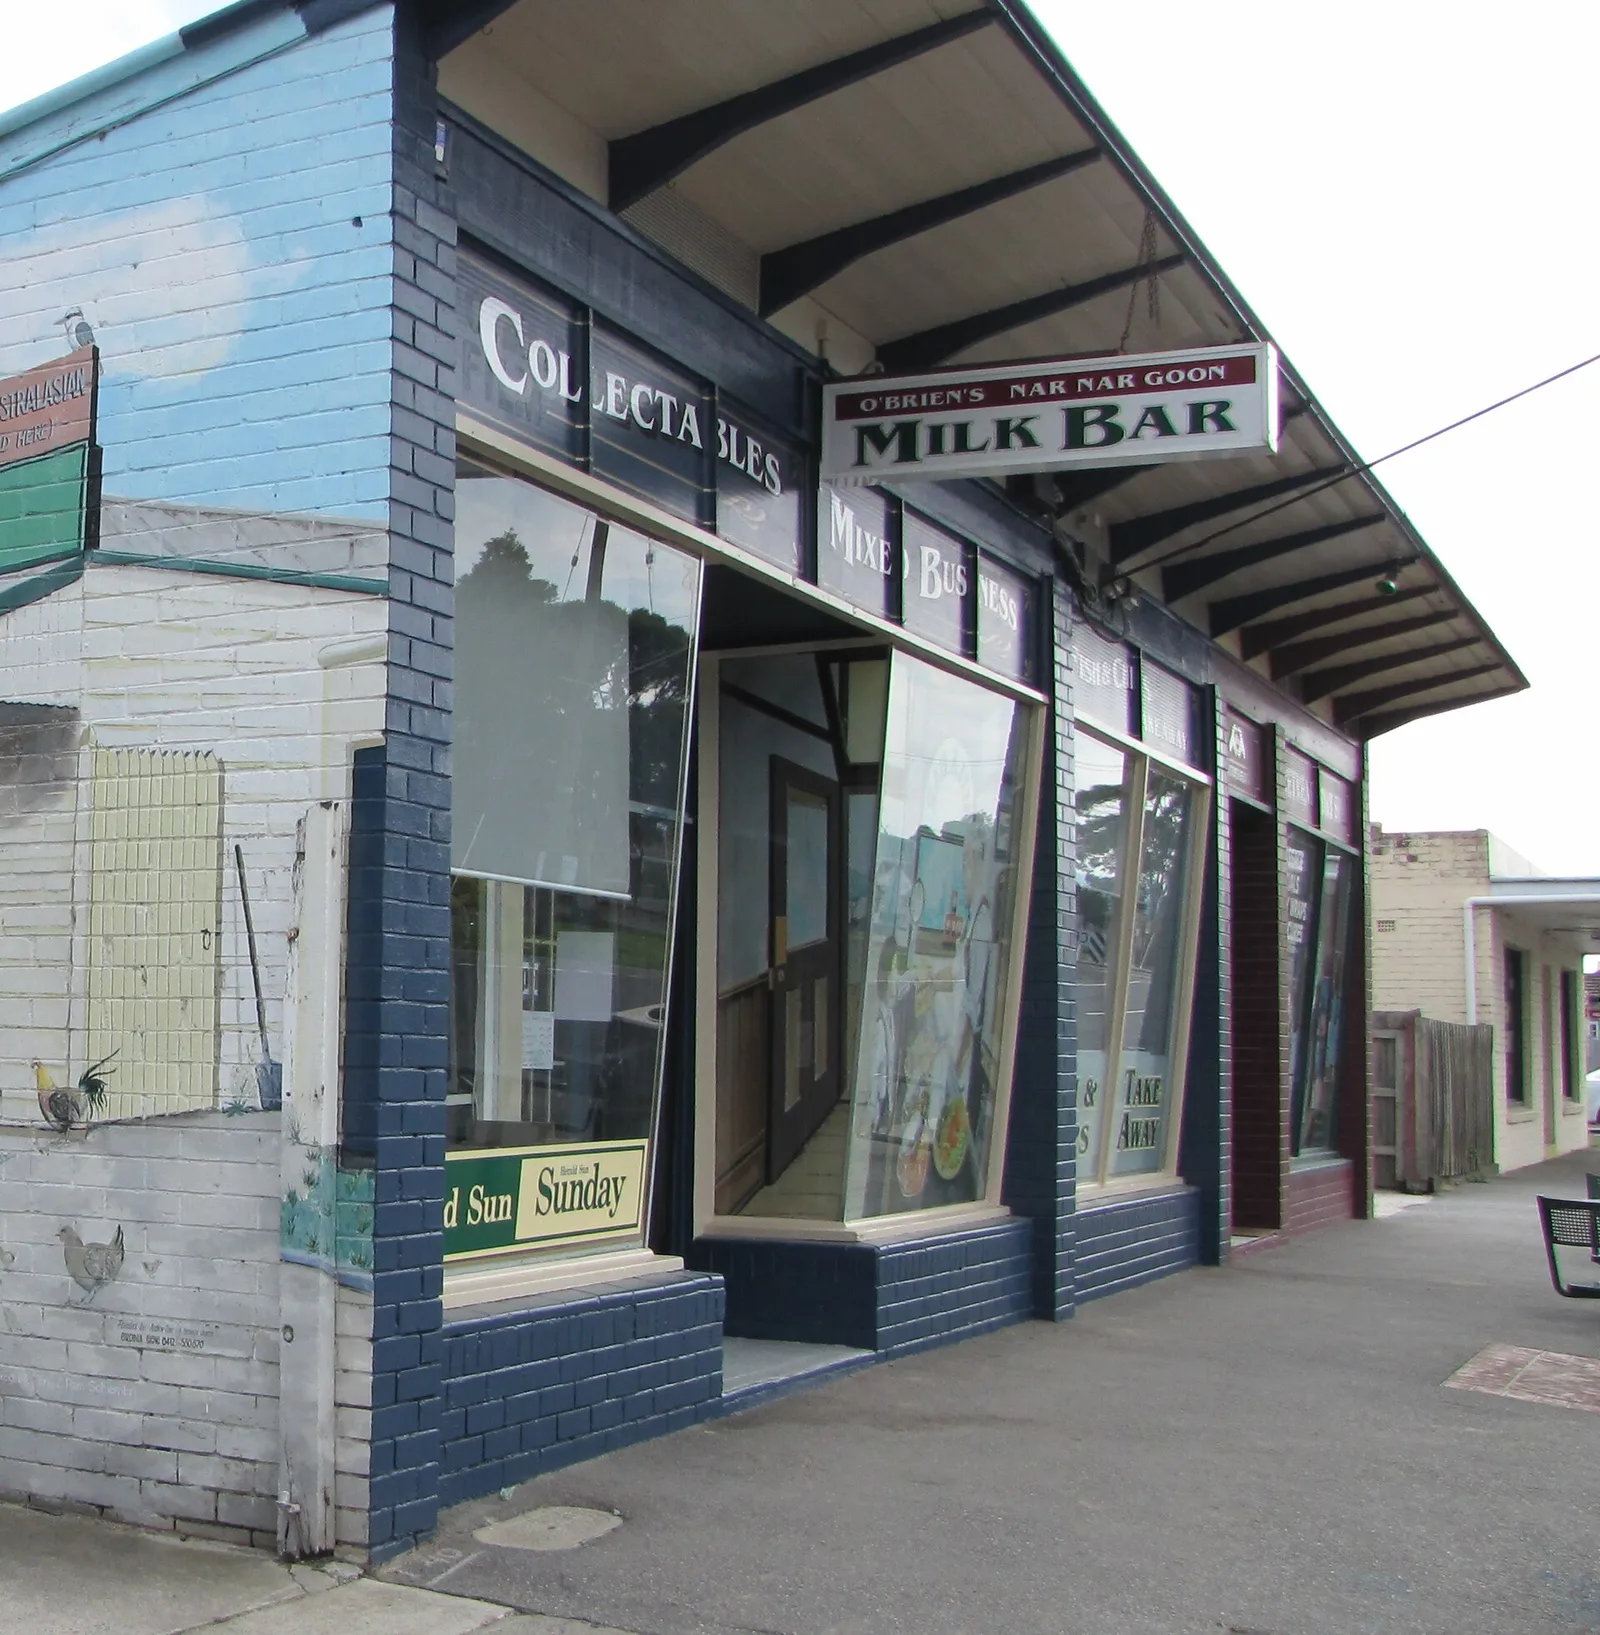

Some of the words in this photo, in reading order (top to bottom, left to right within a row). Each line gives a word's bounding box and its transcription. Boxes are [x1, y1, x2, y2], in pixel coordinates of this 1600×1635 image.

[859, 388, 985, 412] O'BRIEN'S
[1009, 379, 1067, 398] NAR
[1077, 373, 1135, 392] NAR
[1143, 364, 1226, 386] GOON
[852, 415, 1041, 467] MILK
[1060, 399, 1238, 451] BAR
[920, 545, 1017, 631] BUSNESS
[1084, 1079, 1098, 1107] &
[1123, 1069, 1161, 1106] TAKE
[1117, 1112, 1159, 1150] AWAY
[466, 1185, 512, 1225] Sun
[535, 1162, 626, 1218] Sunday
